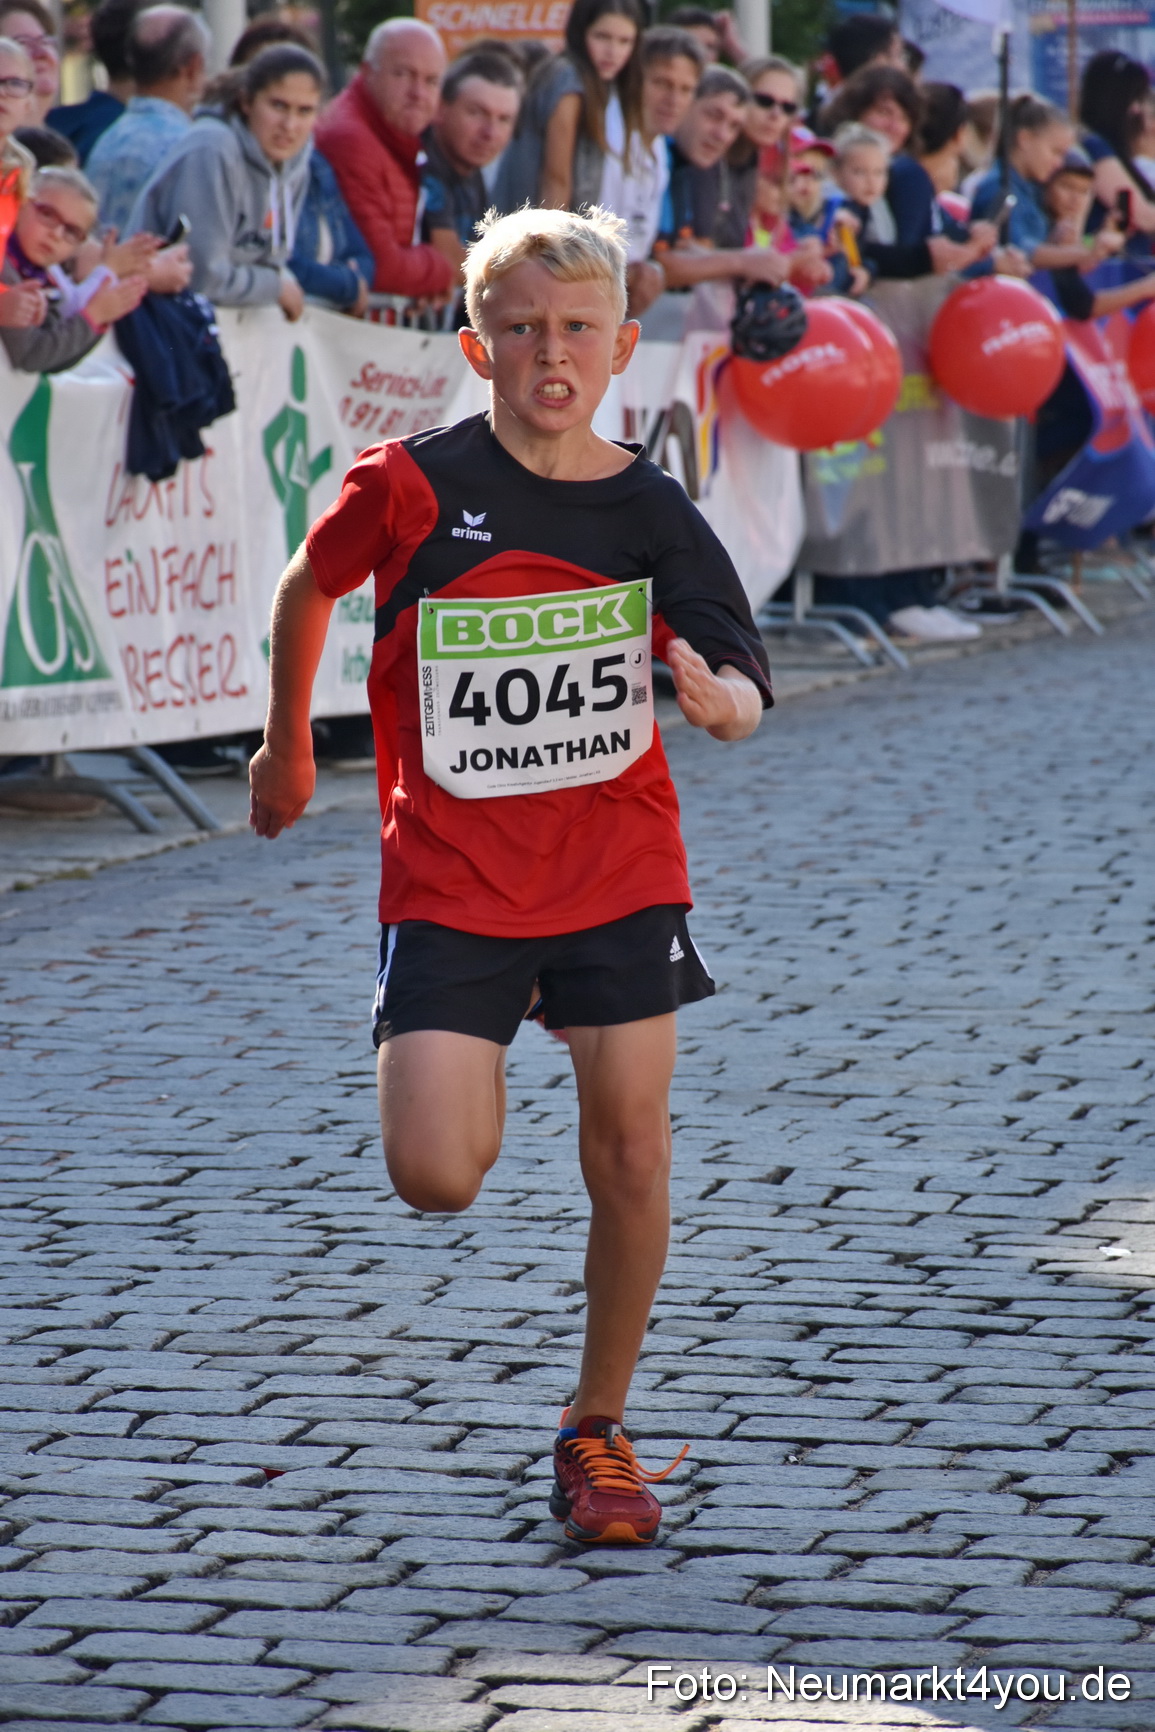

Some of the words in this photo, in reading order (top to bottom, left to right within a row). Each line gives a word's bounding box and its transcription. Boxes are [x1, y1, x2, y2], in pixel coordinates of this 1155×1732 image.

[452, 527, 492, 542] erima
[437, 592, 633, 652] BOCK
[634, 653, 642, 664] J
[449, 653, 628, 727] 4045
[449, 729, 631, 774] JONATHAN
